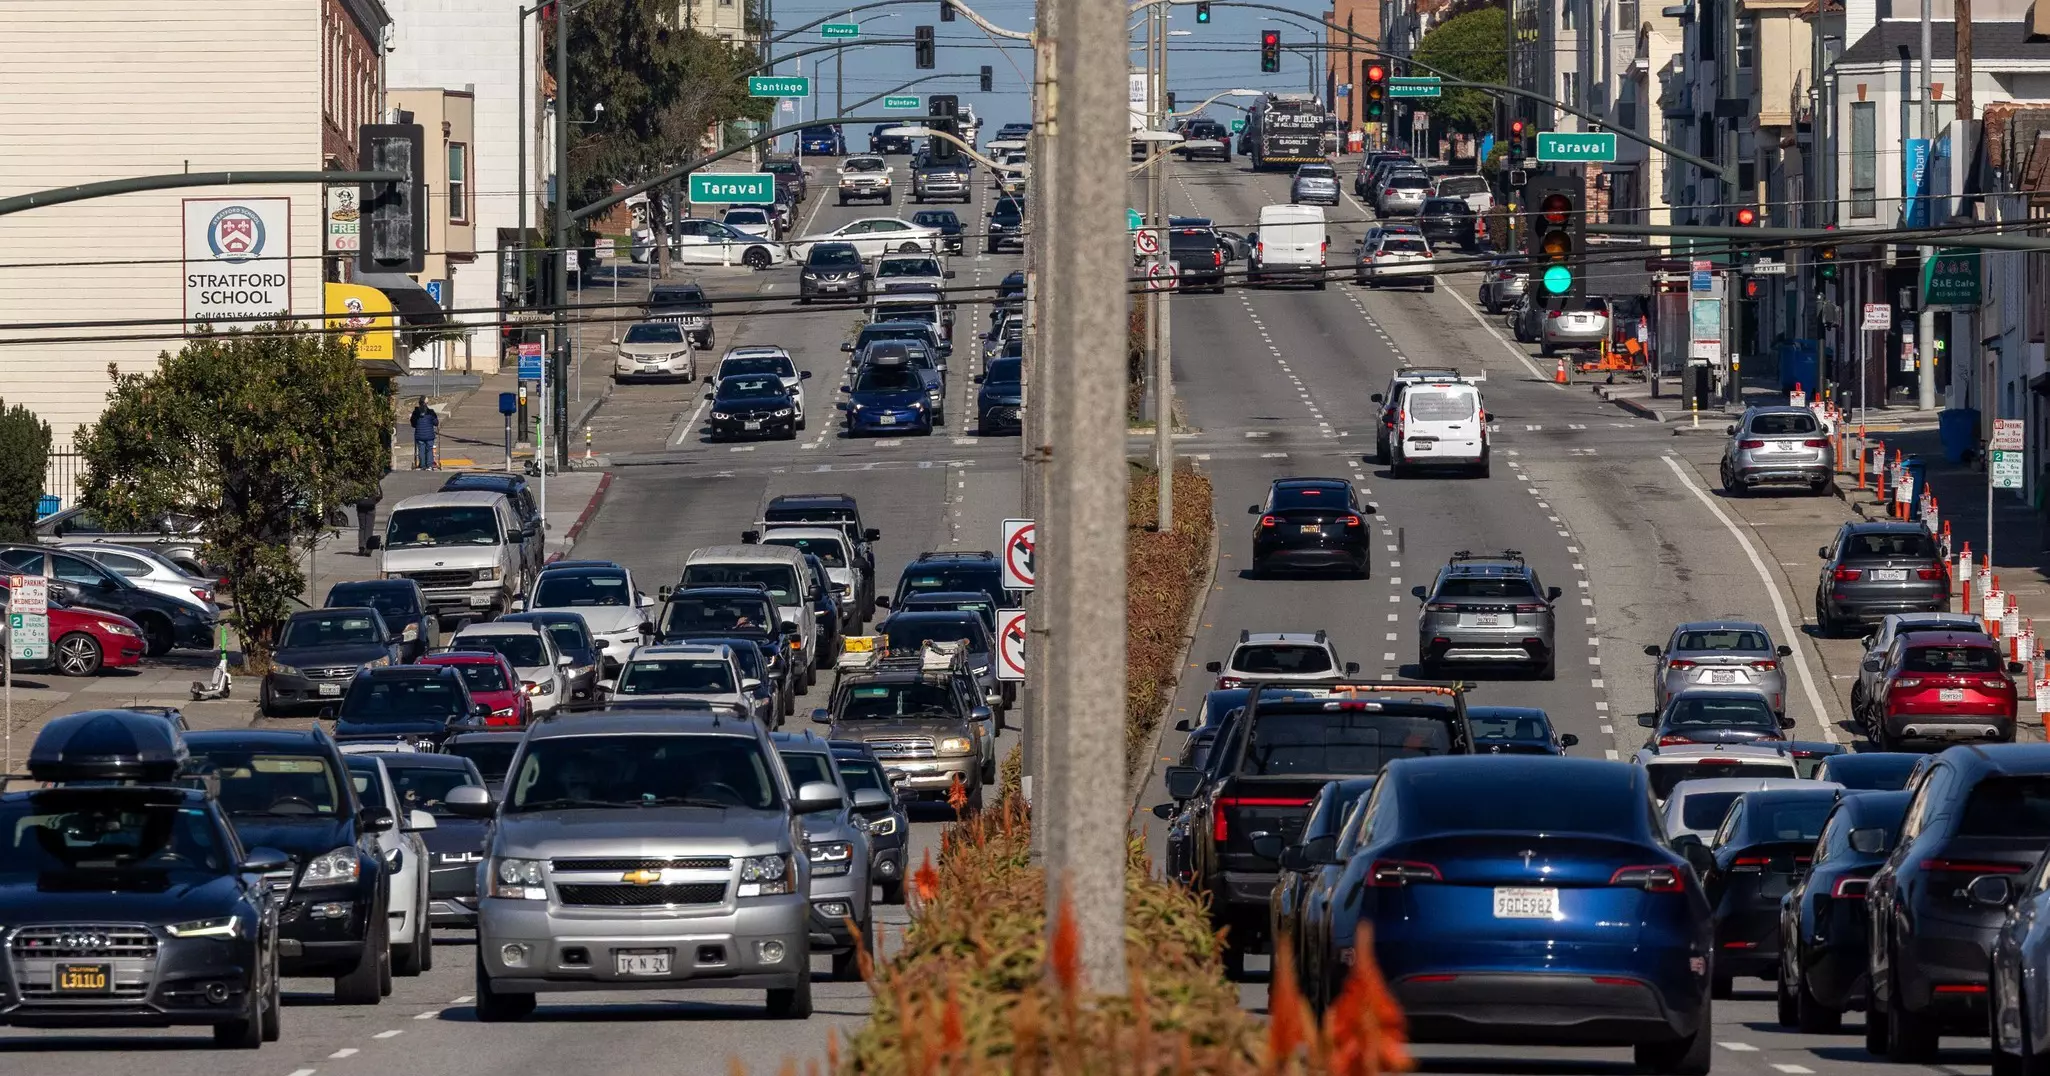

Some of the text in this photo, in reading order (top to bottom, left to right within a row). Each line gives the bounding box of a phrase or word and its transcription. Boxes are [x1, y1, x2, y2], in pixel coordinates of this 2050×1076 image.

[756, 82, 802, 92] Santiago
[1549, 141, 1605, 153] Taraval
[1914, 145, 1924, 187] citibank
[702, 182, 762, 194] Taraval
[213, 208, 260, 224] STRATFORD SCHOOL
[332, 224, 360, 233] FREE
[188, 274, 286, 287] STRATFORD
[1932, 279, 1951, 287] S&E
[201, 291, 272, 304] SCHOOL
[12, 578, 22, 586] NO
[13, 617, 21, 627] 2
[621, 958, 634, 970] TK
[640, 958, 646, 969] N
